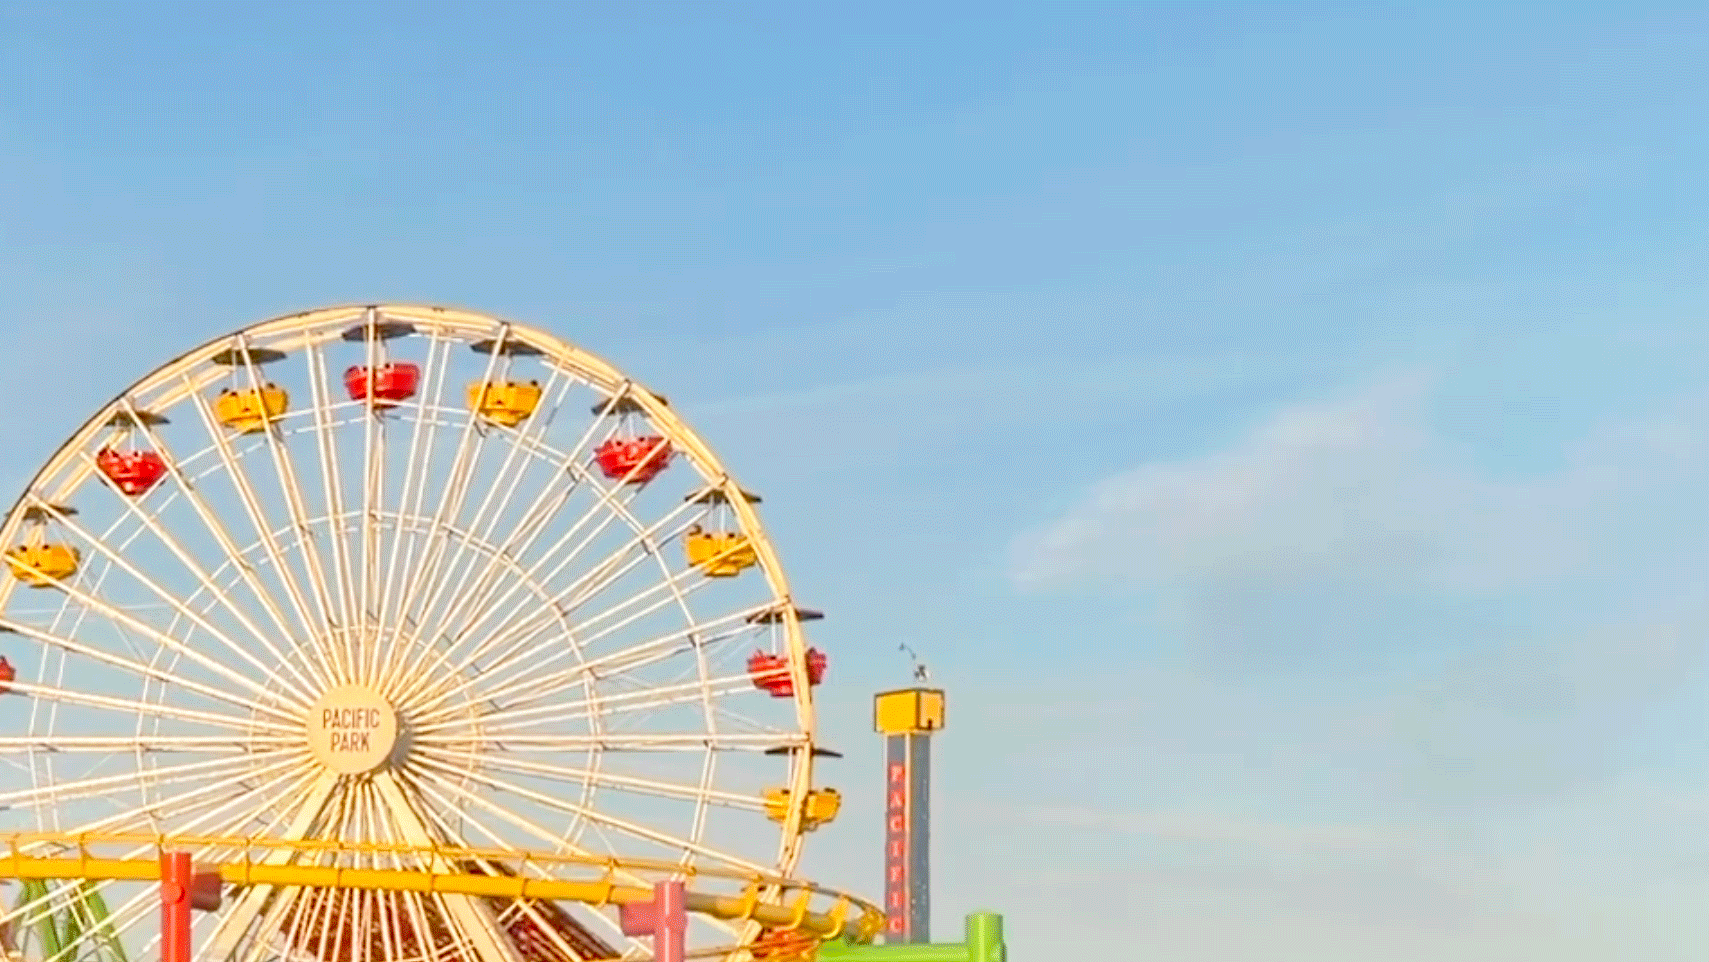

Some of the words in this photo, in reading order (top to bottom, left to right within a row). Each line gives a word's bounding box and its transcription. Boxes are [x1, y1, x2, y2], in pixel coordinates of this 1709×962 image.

[323, 709, 380, 729] PACIFIC
[331, 733, 370, 752] PARK
[889, 764, 904, 934] PACIFIC
